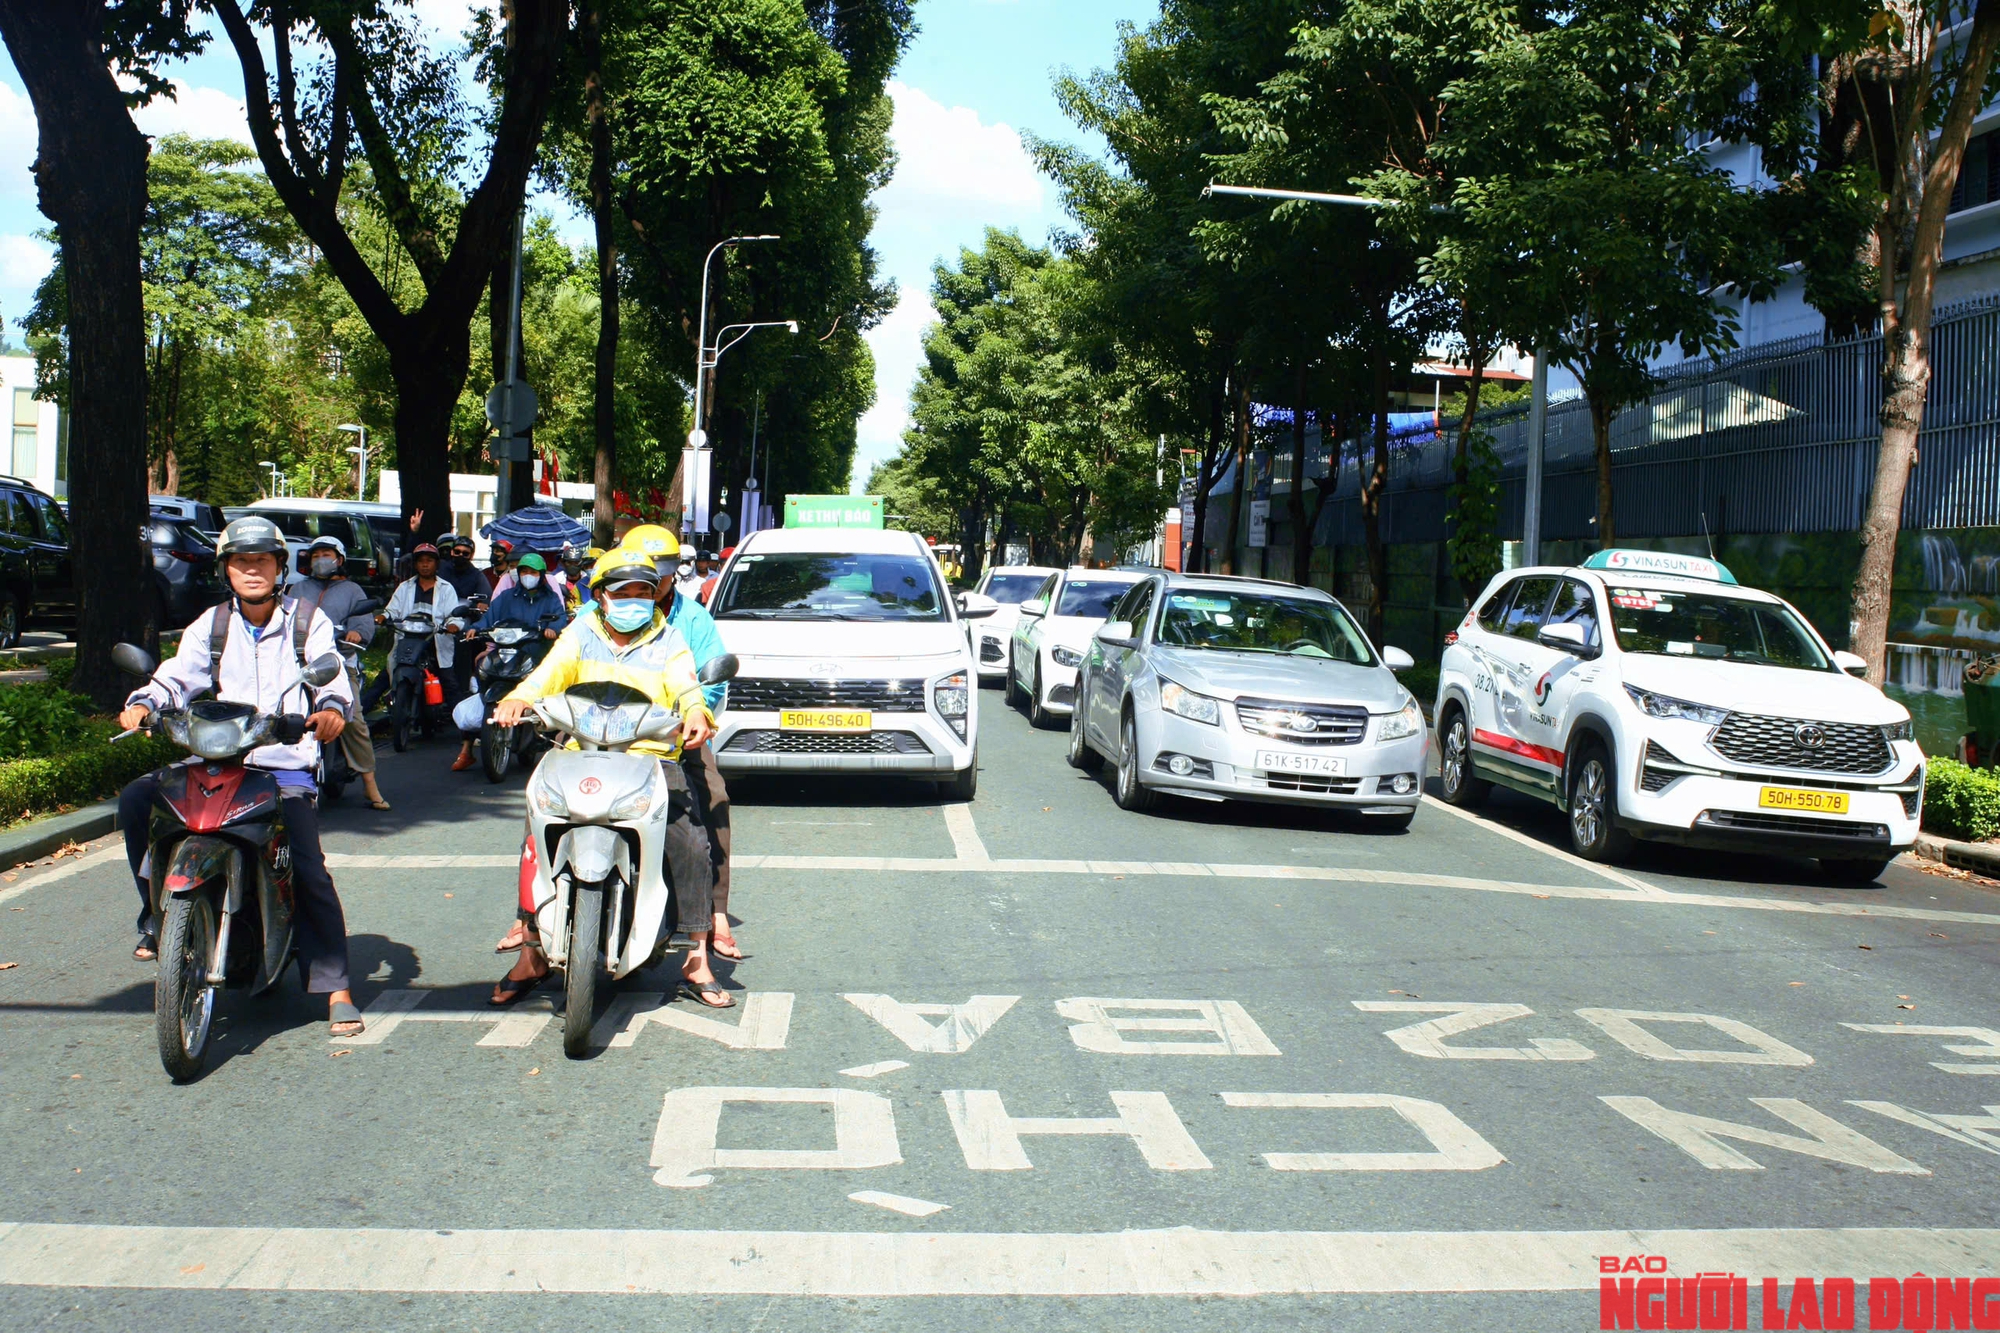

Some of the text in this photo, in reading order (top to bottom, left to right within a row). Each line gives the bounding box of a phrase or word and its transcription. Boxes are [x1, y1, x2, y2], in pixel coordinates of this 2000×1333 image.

[798, 507, 871, 523] XE THƯ BÁO
[1633, 556, 1712, 573] VINASUN TAXI
[788, 714, 863, 727] 50H-496.40
[1264, 754, 1338, 773] 61K-517.42
[1768, 791, 1841, 809] 50H-550.78
